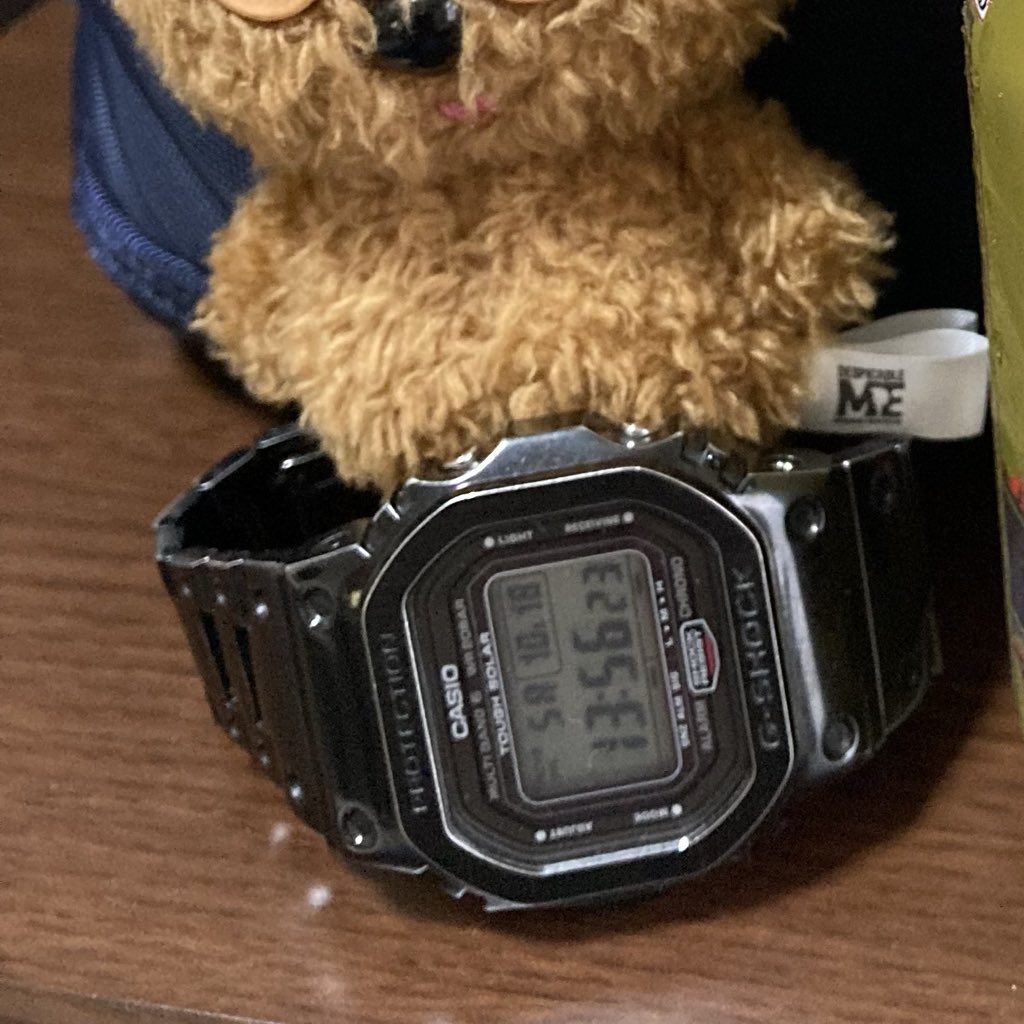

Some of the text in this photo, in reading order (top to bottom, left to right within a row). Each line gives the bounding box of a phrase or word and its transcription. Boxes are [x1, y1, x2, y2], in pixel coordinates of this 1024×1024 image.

[441, 664, 469, 741] CASIO
[479, 630, 510, 757] TOUGH SOLAR
[731, 567, 781, 751] G-SHOCK
